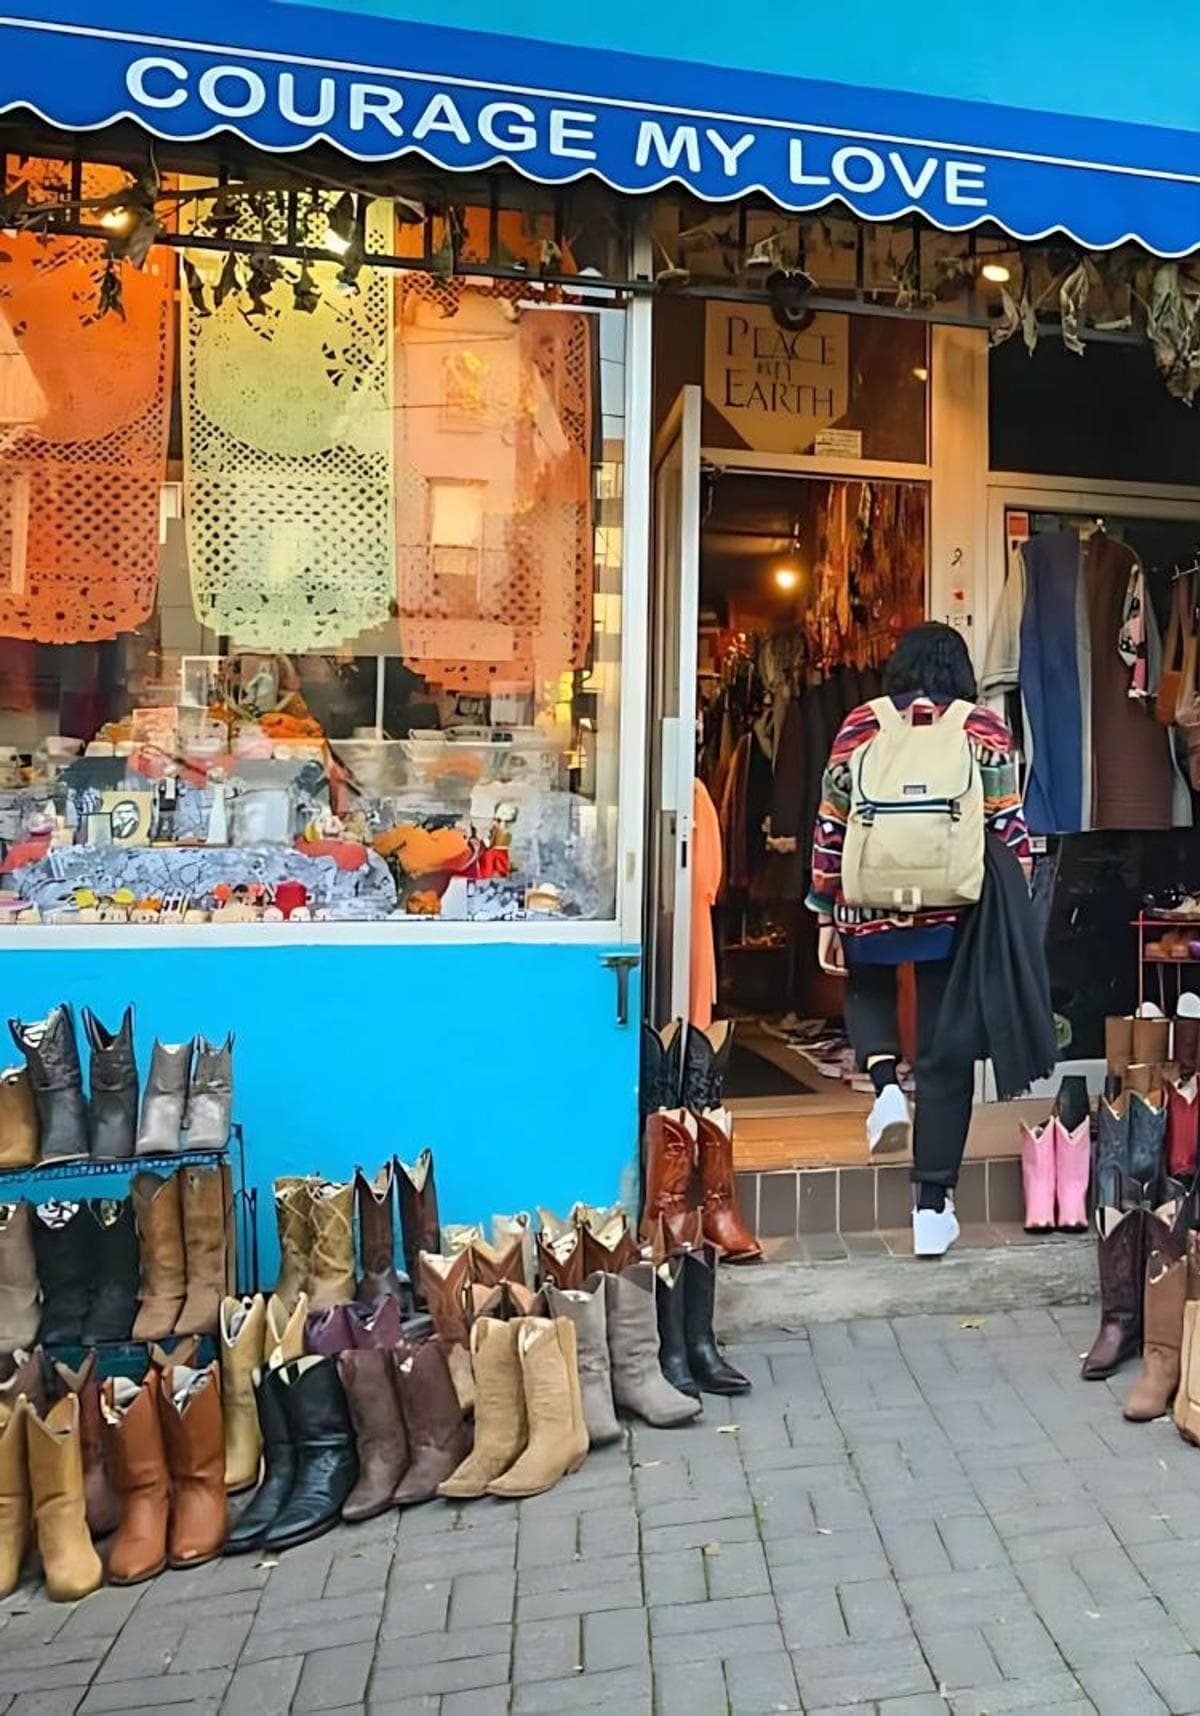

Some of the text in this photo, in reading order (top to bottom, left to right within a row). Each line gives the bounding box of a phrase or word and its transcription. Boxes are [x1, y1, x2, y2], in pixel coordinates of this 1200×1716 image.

[126, 56, 988, 207] COURAGE MY LOVE
[724, 368, 834, 418] EARTH
